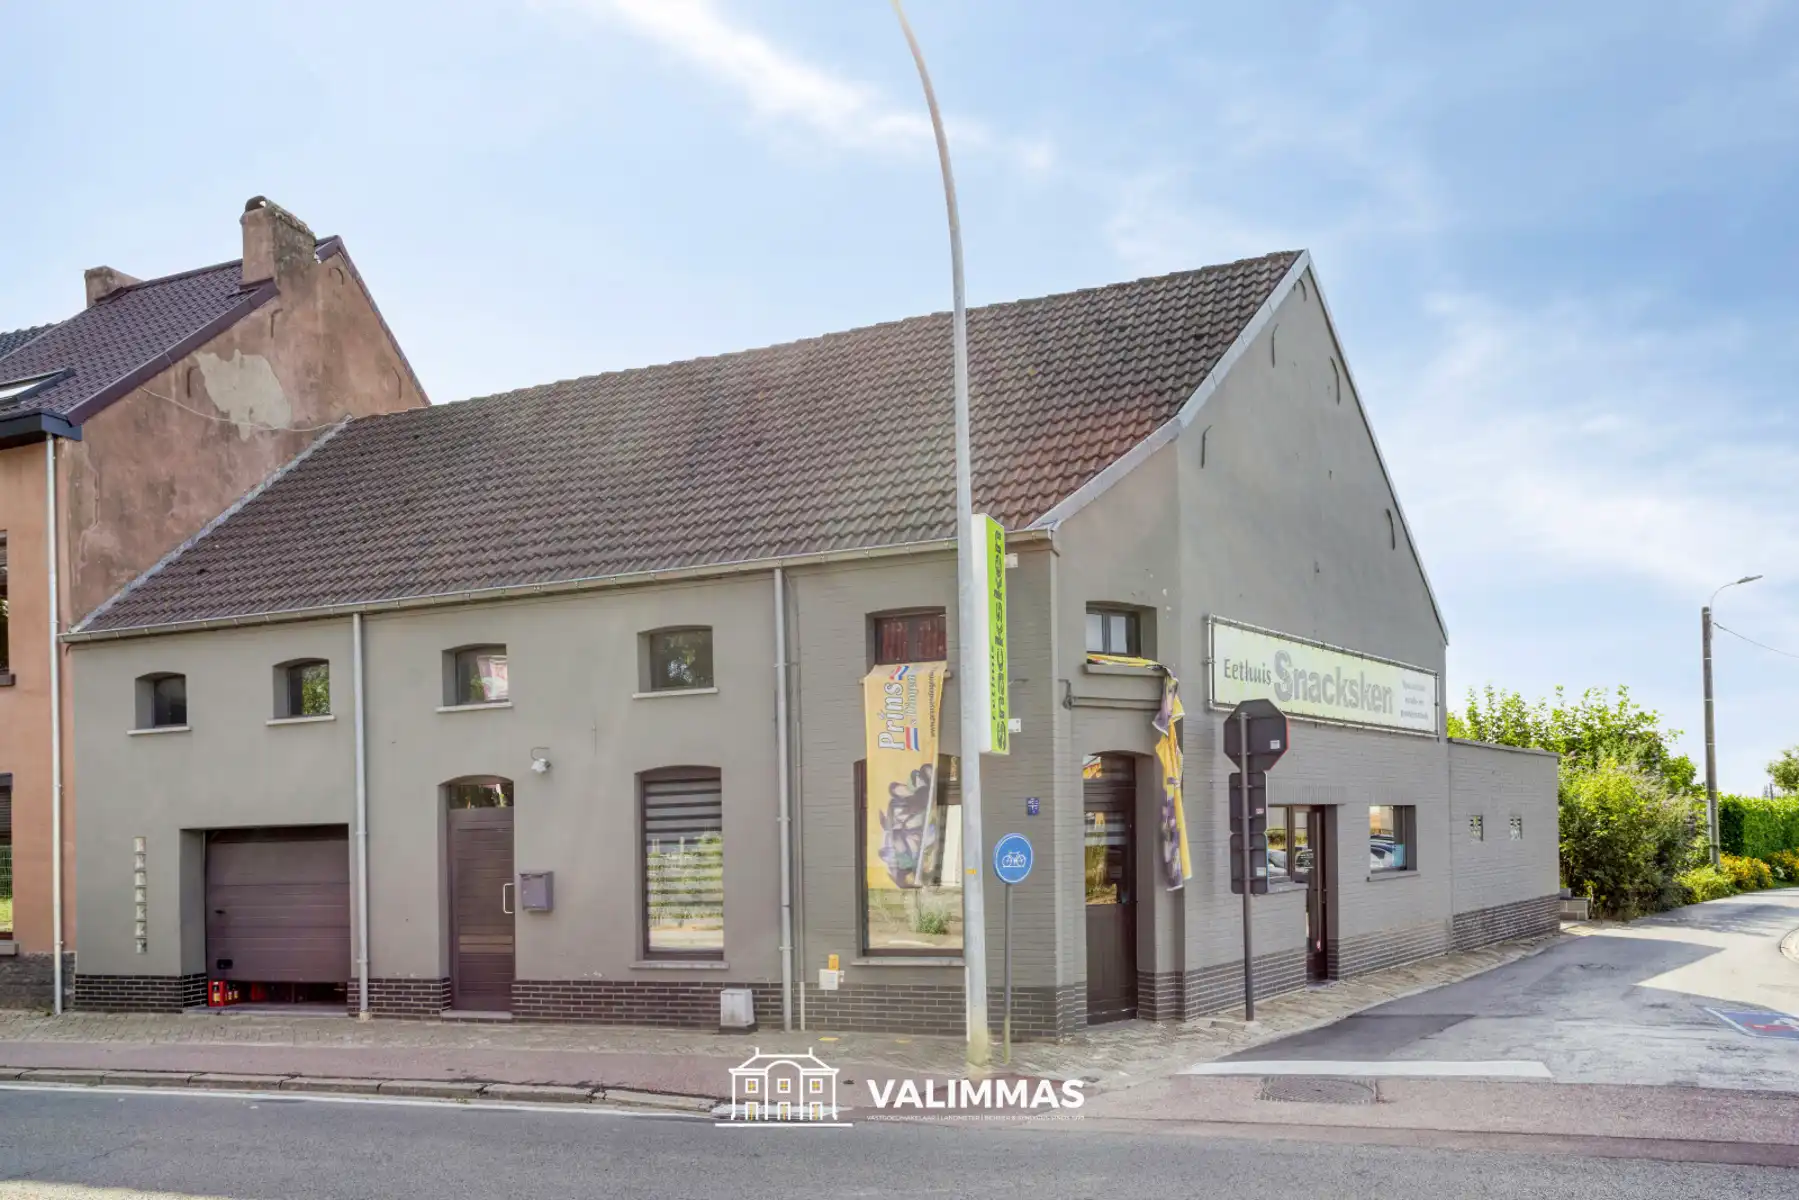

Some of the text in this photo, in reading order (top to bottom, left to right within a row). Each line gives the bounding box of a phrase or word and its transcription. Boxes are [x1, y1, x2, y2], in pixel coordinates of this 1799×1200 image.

[993, 529, 1006, 751] Snacksken
[877, 681, 906, 751] Prins
[1224, 649, 1393, 715] Eethuis Snacksken
